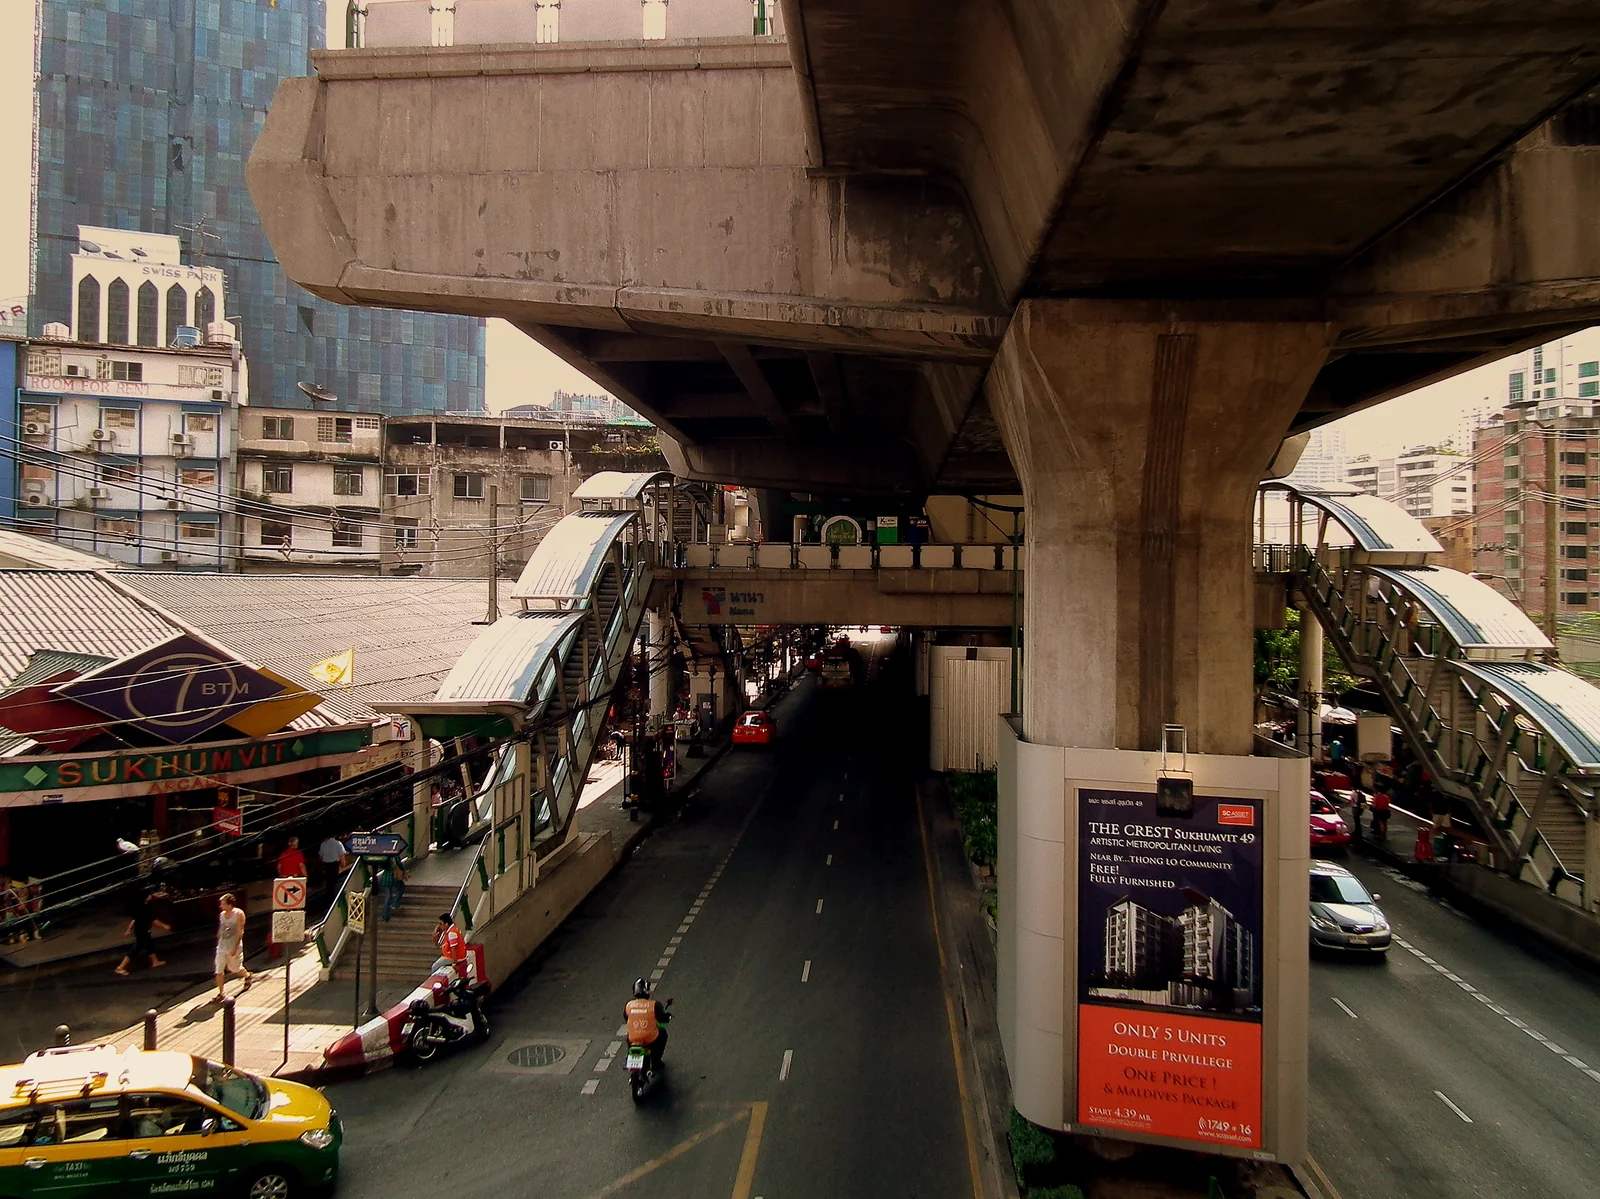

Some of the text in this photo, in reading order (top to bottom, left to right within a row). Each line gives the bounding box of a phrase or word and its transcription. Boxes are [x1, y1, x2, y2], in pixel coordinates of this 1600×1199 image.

[142, 266, 216, 281] SWISS PARK
[31, 376, 151, 395] ROOM FOR RENT
[168, 665, 200, 712] 7
[201, 682, 249, 696] BTM
[57, 742, 287, 786] SUKHUMVIT
[148, 774, 229, 794] ARCADE
[1089, 822, 1255, 844] THE CREST SUKHUMVIT 49
[391, 840, 399, 850] 7
[1090, 838, 1222, 854] ARTISTIC METROPOLITAN LIVING
[1090, 853, 1112, 861] NEAR
[1166, 857, 1178, 866] LO
[1179, 859, 1232, 870] COMMUNITY
[1090, 863, 1119, 875] FREE!
[1090, 874, 1175, 889] FULLY FURNISHED
[1113, 1022, 1226, 1047] ONLY 5 UNITS
[1107, 1043, 1233, 1069] DOUBLE PRIVILLEGE
[1123, 1066, 1157, 1082] ONE
[1163, 1071, 1207, 1090] PRICE
[1103, 1083, 1238, 1110] & MALDIVES PACKAGE
[1088, 1105, 1112, 1116] START
[1114, 1107, 1137, 1119] 4.39
[1207, 1119, 1230, 1131] 1749
[1239, 1124, 1252, 1135] 16
[65, 1162, 83, 1171] TAXI
